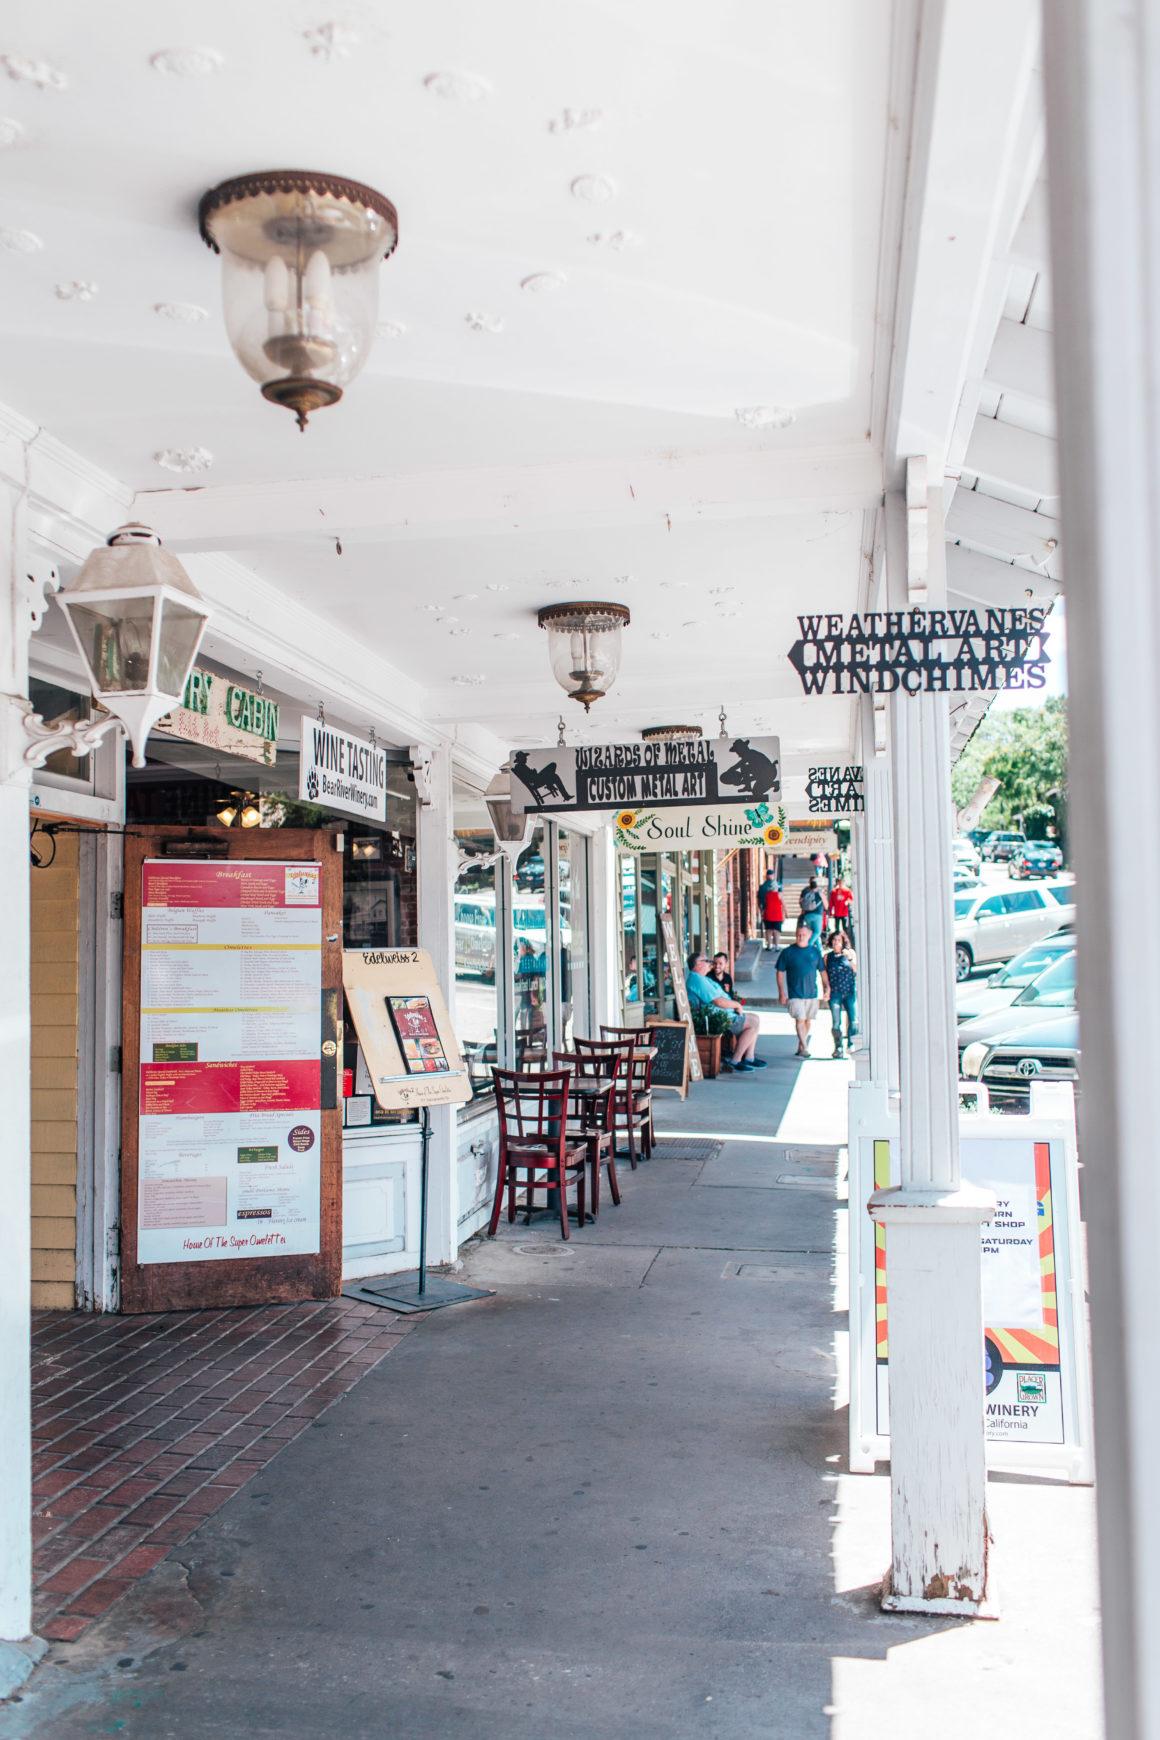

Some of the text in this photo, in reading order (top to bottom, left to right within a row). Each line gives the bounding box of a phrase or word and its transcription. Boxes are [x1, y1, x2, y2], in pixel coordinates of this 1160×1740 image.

[797, 608, 1045, 638] WEATHERVANES
[815, 634, 1032, 667] METAL ART
[800, 664, 1047, 696] WINDCHIMES
[226, 686, 278, 742] CABIN
[313, 727, 384, 789] WINE TASTING
[575, 740, 714, 770] WIZARDS OF METAL
[322, 774, 378, 809] BearRiverWinery.com
[589, 771, 704, 801] CUSTOM METAL ART
[647, 814, 752, 840] Soul Shine
[216, 871, 252, 880] Breakfast
[363, 951, 420, 965] Edelweiss 2
[292, 1127, 310, 1136] Sides
[215, 1236, 228, 1248] The
[229, 1235, 248, 1251] Super
[986, 1404, 1039, 1417] WINERY
